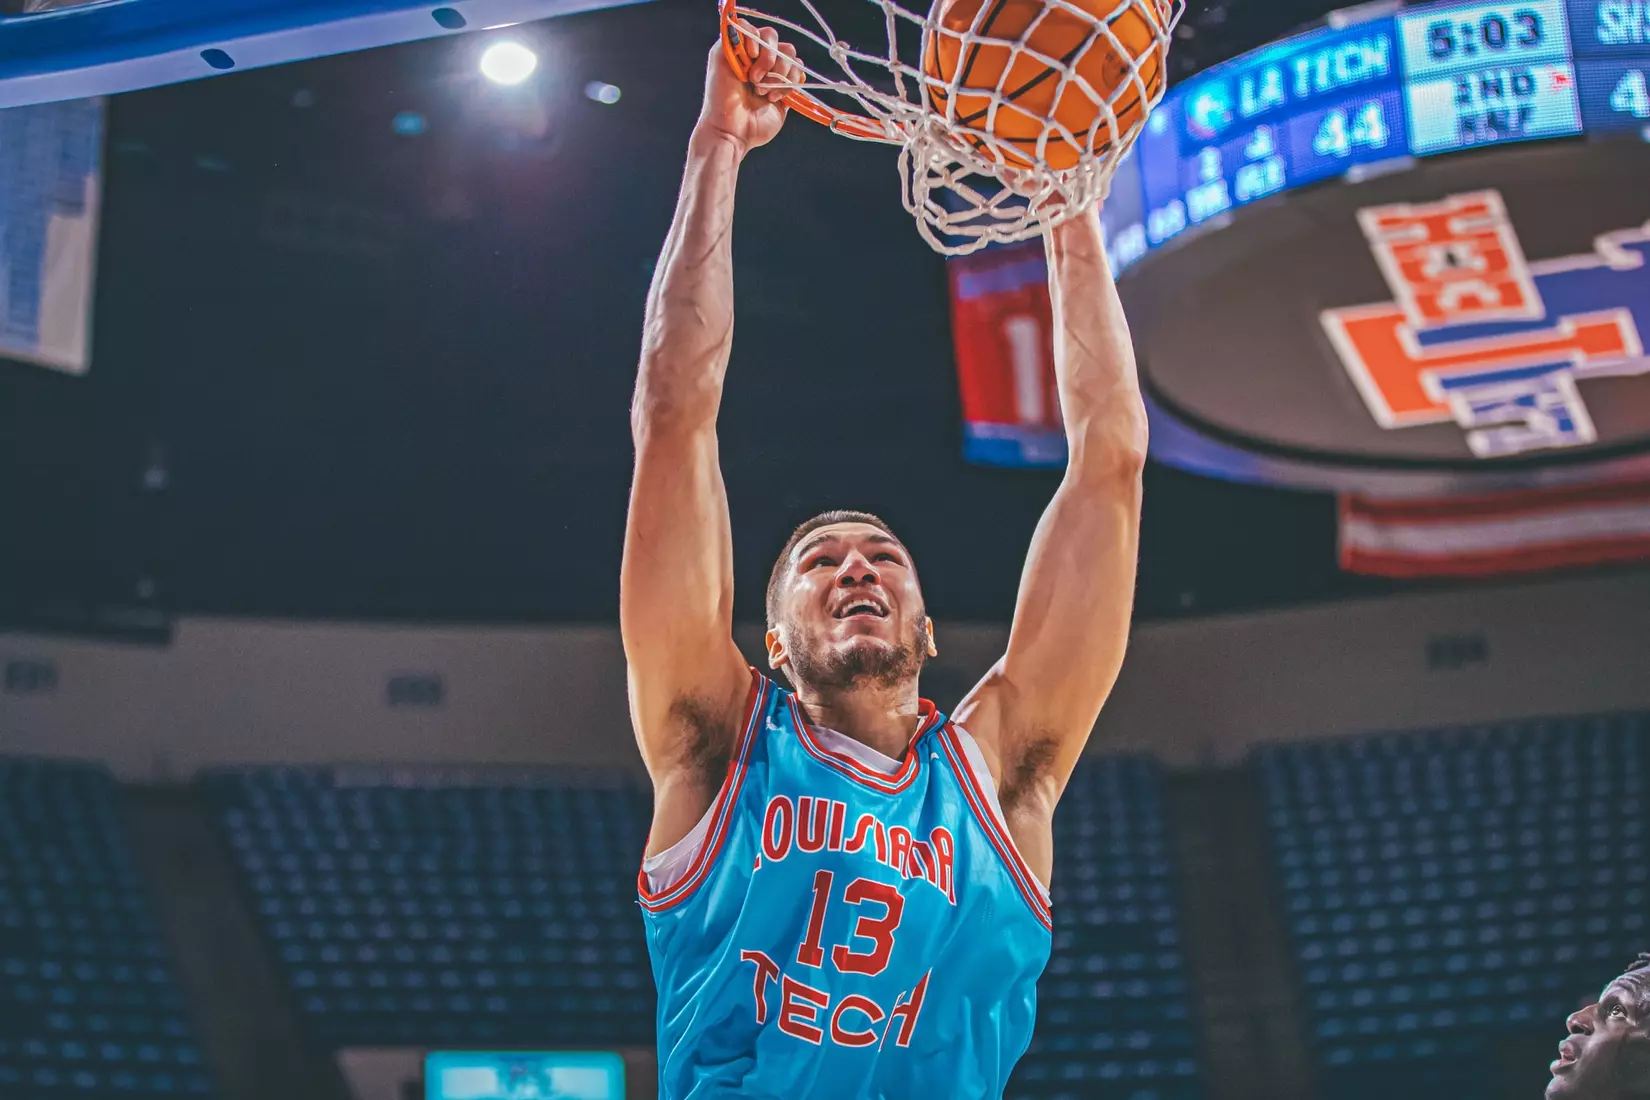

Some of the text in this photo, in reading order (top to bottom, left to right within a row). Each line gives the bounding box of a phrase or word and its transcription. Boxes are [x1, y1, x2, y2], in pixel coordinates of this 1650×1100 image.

[1597, 0, 1650, 44] SH
[1240, 33, 1392, 117] LA TECH
[1313, 99, 1389, 158] 44
[754, 795, 957, 906] OUISIANA
[796, 868, 905, 977] 13
[740, 949, 932, 1052] TECH
